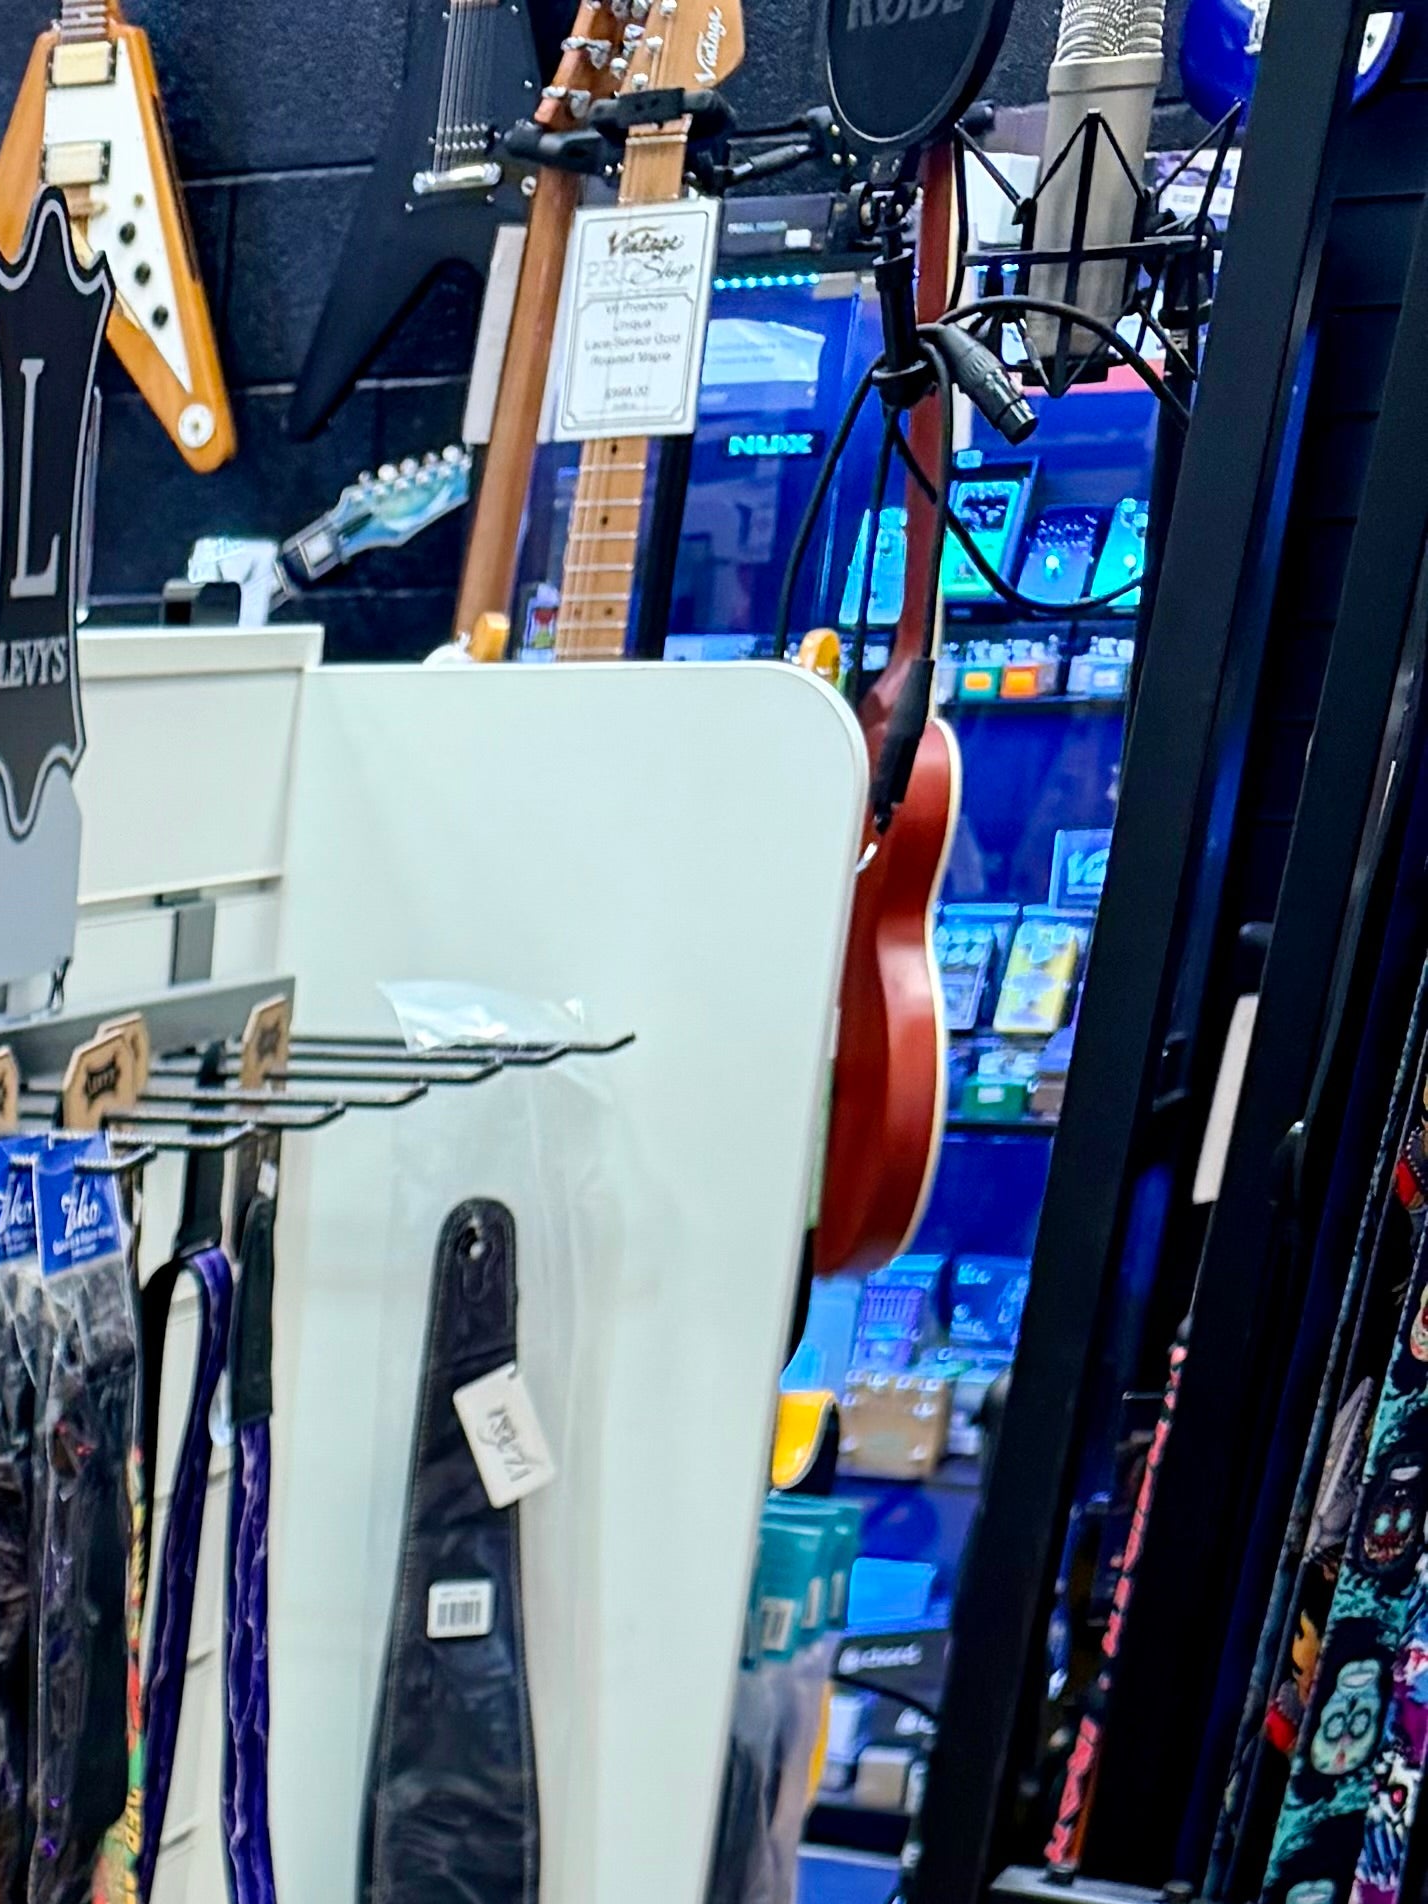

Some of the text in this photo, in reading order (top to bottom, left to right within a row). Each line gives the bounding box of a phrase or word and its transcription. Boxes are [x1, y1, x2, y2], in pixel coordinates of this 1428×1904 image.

[694, 5, 727, 84] Vintage
[608, 226, 685, 257] Vintage
[729, 433, 814, 457] NUX
